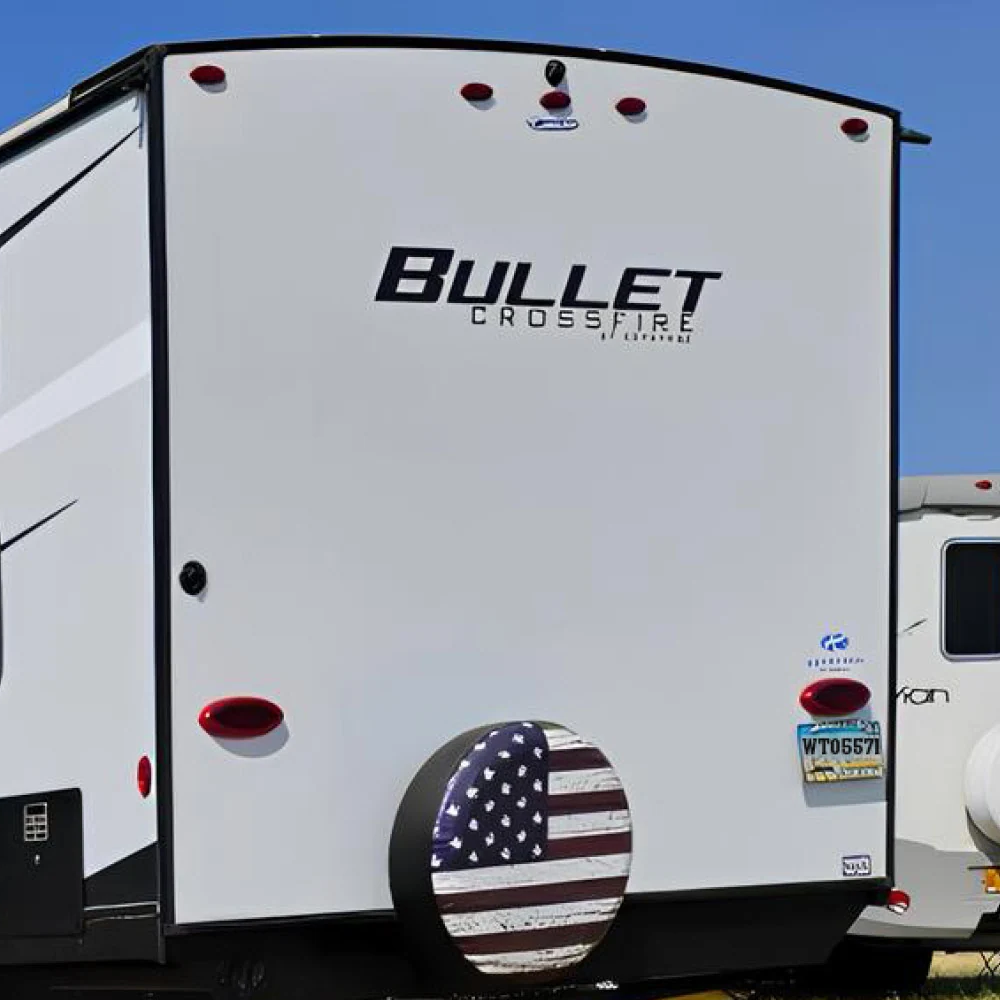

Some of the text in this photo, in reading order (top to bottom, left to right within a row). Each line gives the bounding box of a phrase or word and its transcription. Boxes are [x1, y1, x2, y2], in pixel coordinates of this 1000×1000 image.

[374, 246, 723, 313] BULLET
[470, 306, 694, 336] CROSSFIRE
[802, 737, 880, 755] WT05571
